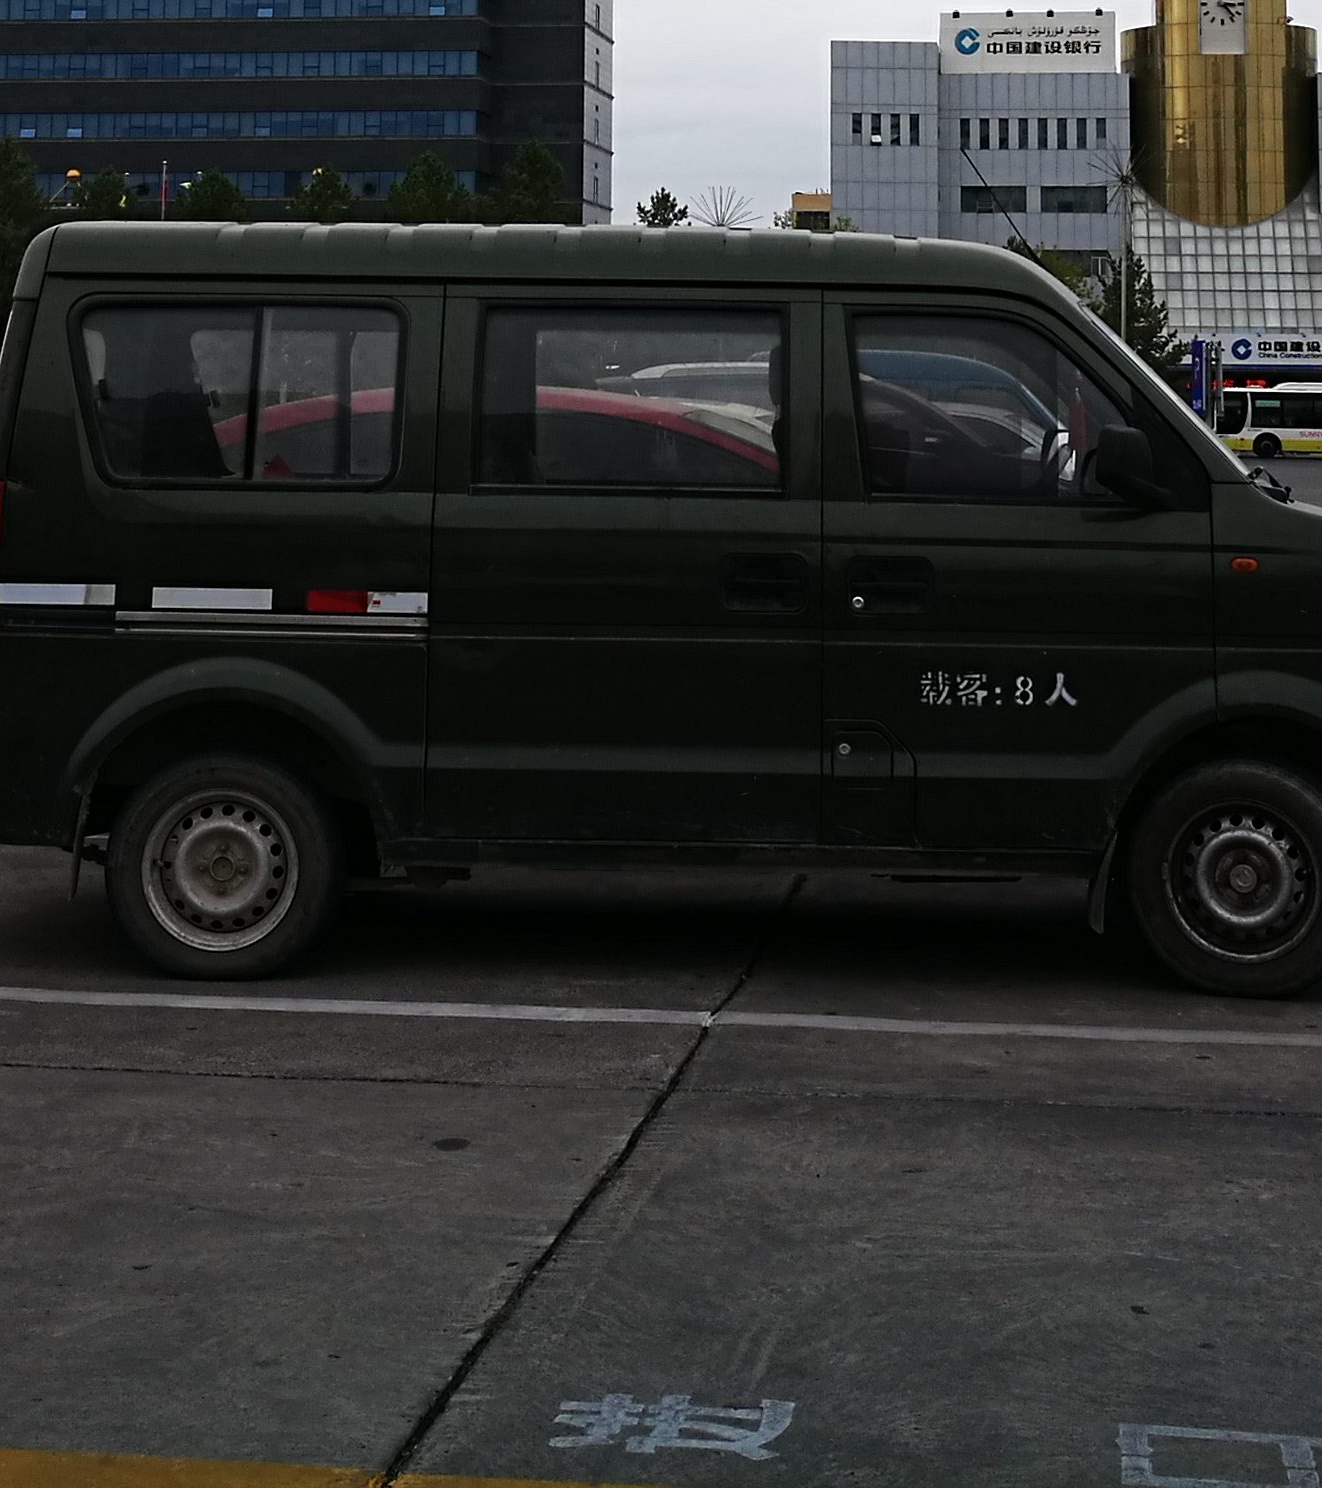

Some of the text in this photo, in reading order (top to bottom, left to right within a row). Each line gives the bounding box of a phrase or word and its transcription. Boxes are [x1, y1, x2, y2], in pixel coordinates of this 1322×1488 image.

[986, 40, 1102, 55] 中国建设银行
